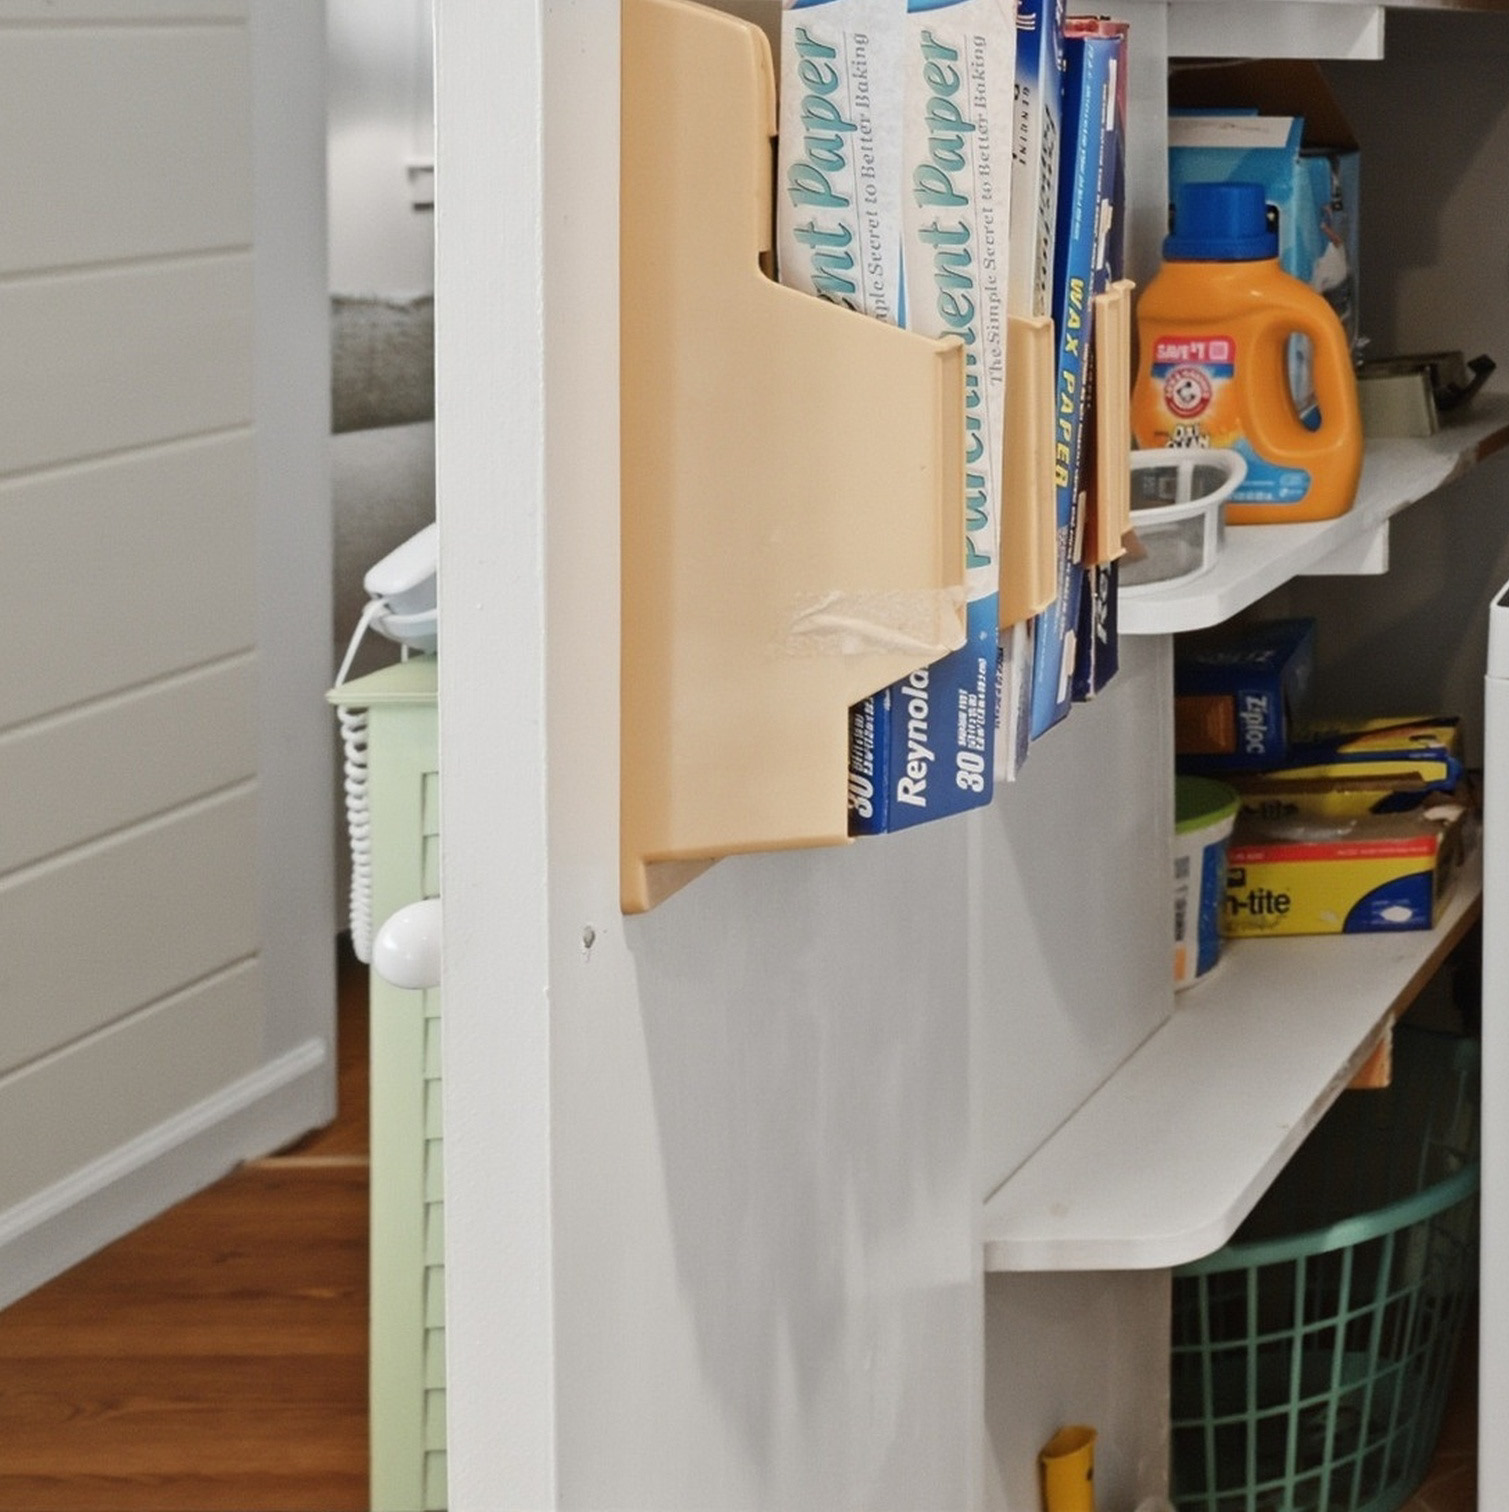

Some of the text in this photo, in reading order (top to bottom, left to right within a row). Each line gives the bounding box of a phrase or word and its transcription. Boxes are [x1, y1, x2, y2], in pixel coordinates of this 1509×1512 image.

[851, 33, 870, 108] Baking
[787, 28, 858, 208] Paper
[860, 113, 876, 178] Better
[913, 29, 976, 207] Paper
[865, 184, 878, 204] to
[971, 35, 1003, 386] The Simple Secret to Better Baking
[866, 210, 884, 277] Secret
[1065, 277, 1084, 356] WAX
[1156, 343, 1189, 360] SAVE
[1056, 370, 1076, 488] PAPER
[1240, 696, 1268, 754] Ziploc
[955, 751, 985, 792] 30
